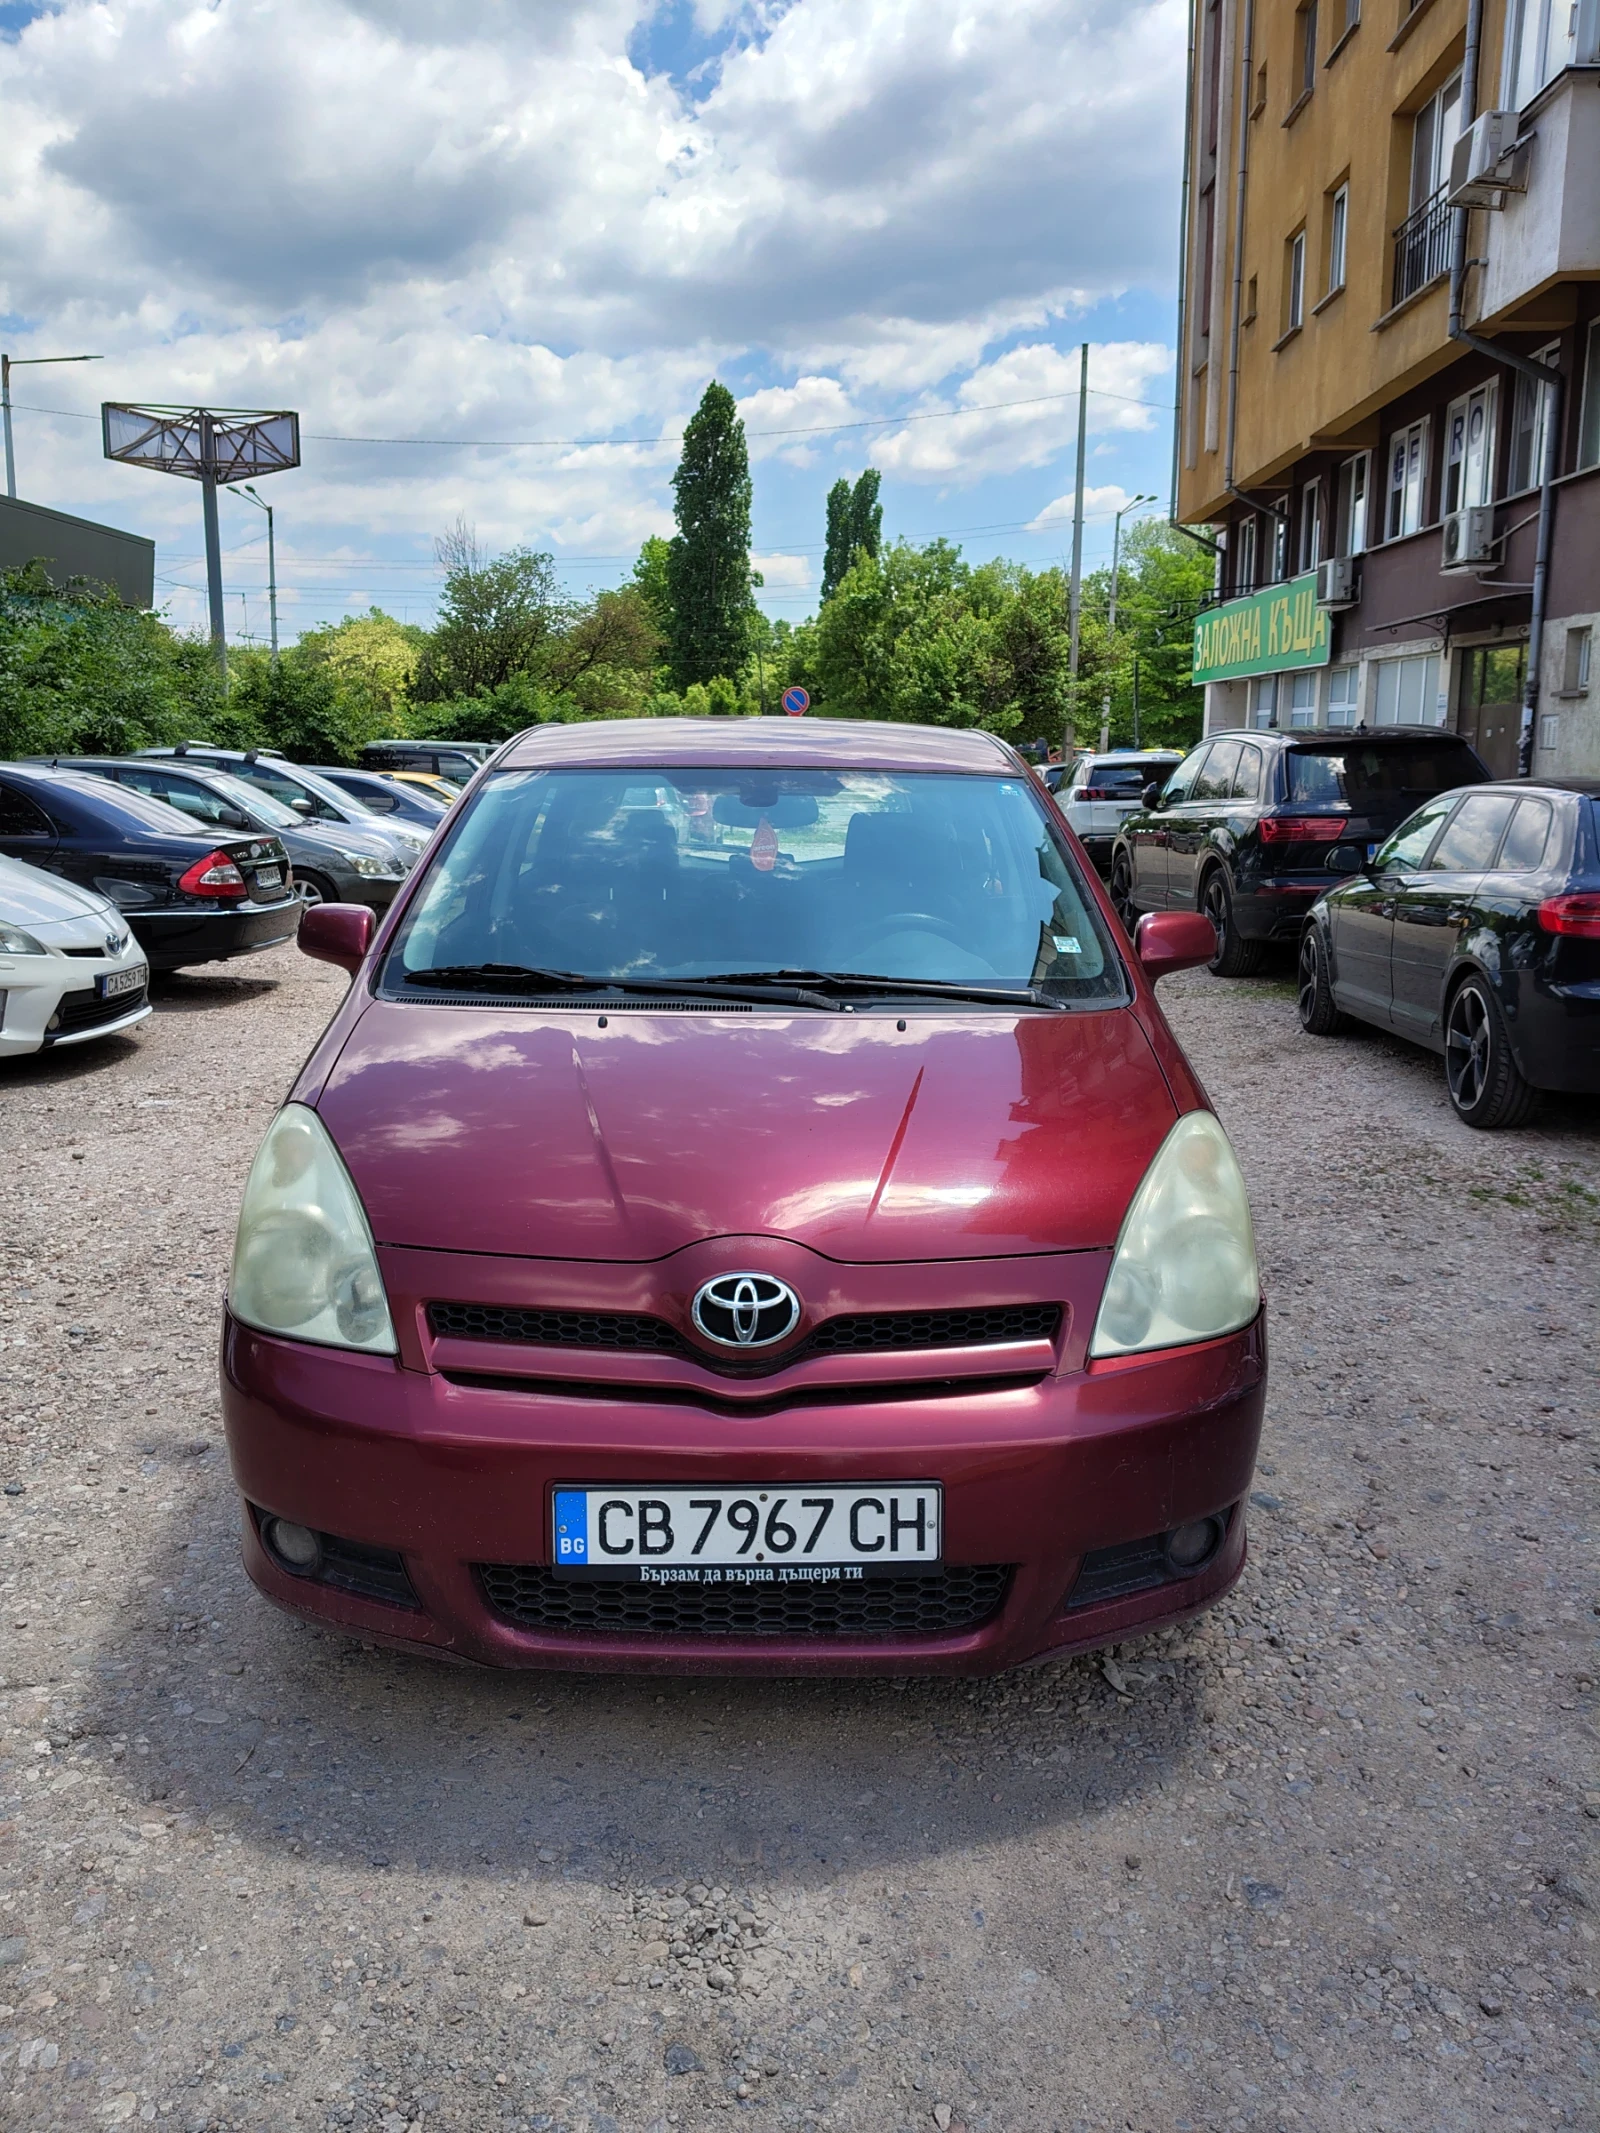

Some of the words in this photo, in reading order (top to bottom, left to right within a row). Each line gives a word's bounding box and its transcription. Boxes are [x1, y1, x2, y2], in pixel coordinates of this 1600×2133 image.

[1195, 606, 1261, 671] ЗАЛОЖНА
[1267, 589, 1326, 658] КЪЩА
[599, 1500, 674, 1555] CB
[689, 1498, 834, 1554] 7967
[850, 1498, 925, 1552] CH
[560, 1537, 585, 1555] BG
[640, 1566, 700, 1586] Бързам
[703, 1570, 721, 1585] да
[725, 1568, 774, 1586] върна
[778, 1567, 841, 1584] дъщеря
[843, 1567, 863, 1579] ти
